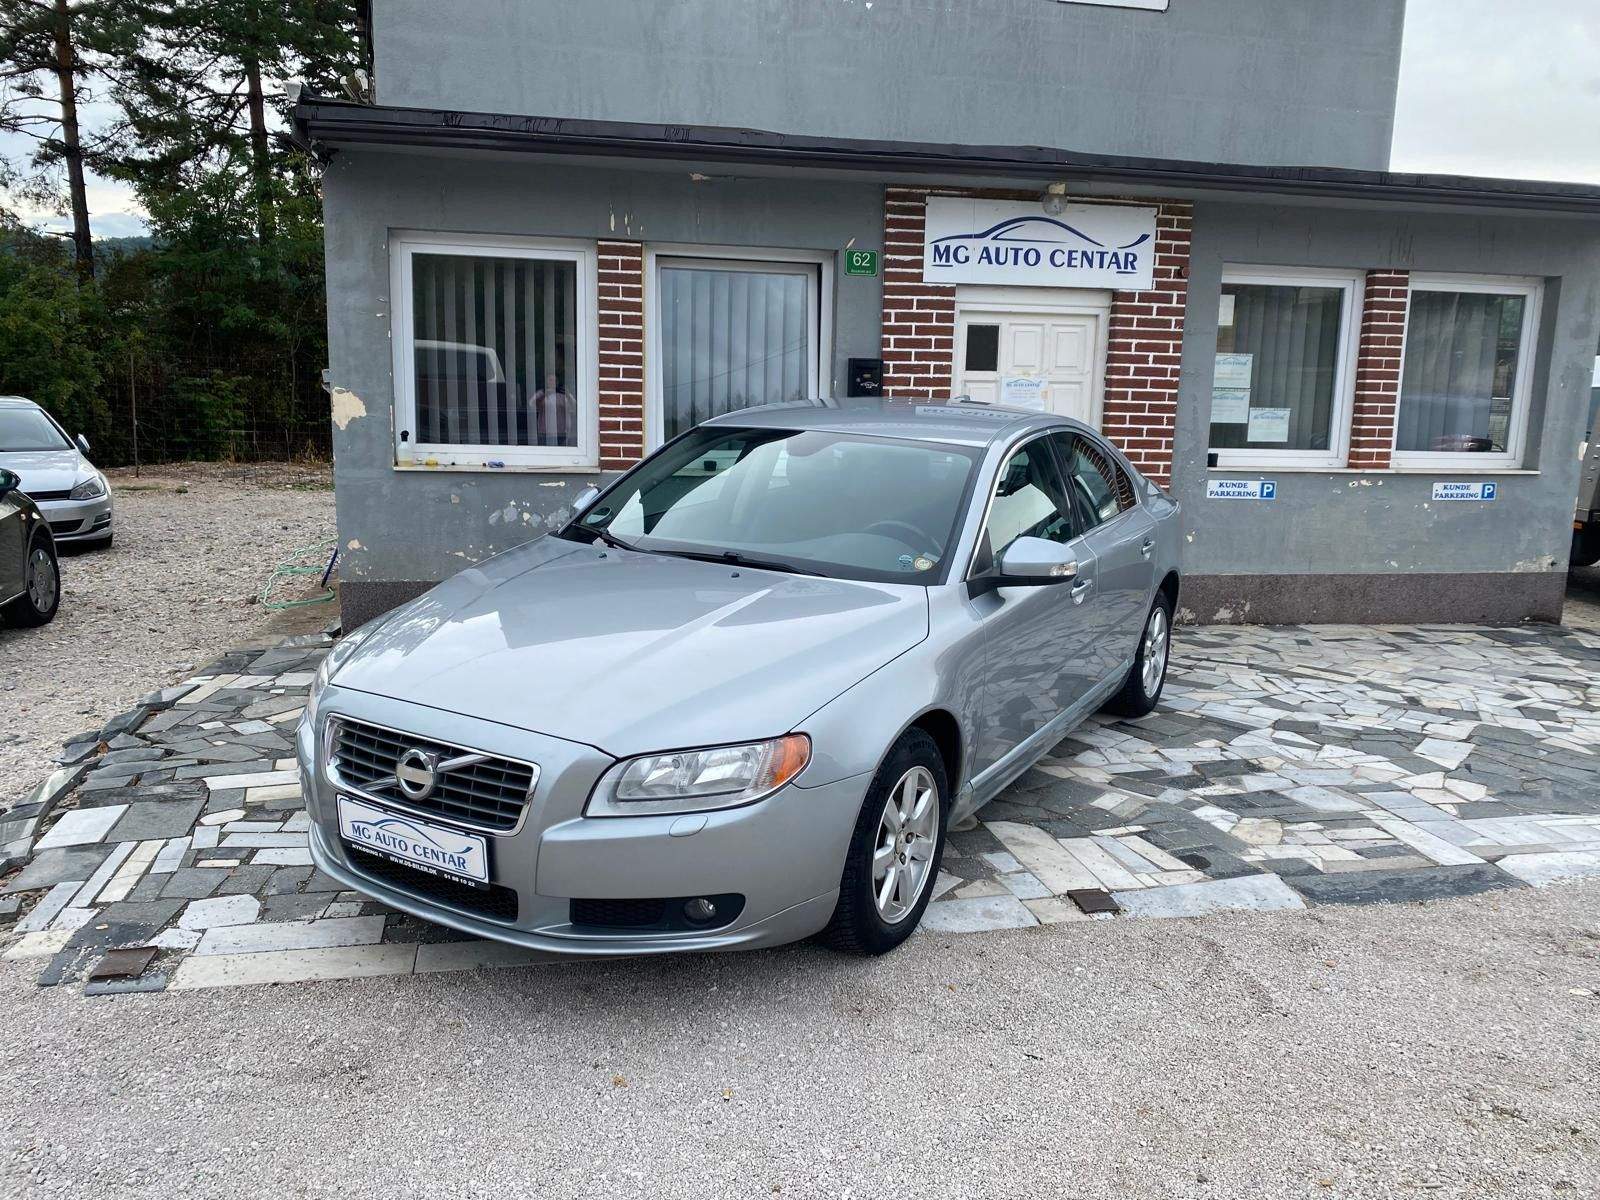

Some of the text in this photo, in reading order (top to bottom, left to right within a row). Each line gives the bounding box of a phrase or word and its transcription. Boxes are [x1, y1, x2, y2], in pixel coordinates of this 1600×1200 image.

[853, 252, 870, 266] 62
[932, 244, 1138, 271] MG AUTO CENTAR
[1263, 484, 1273, 496] P
[1484, 485, 1494, 497] P
[351, 823, 467, 869] MG AUTO CENTAR
